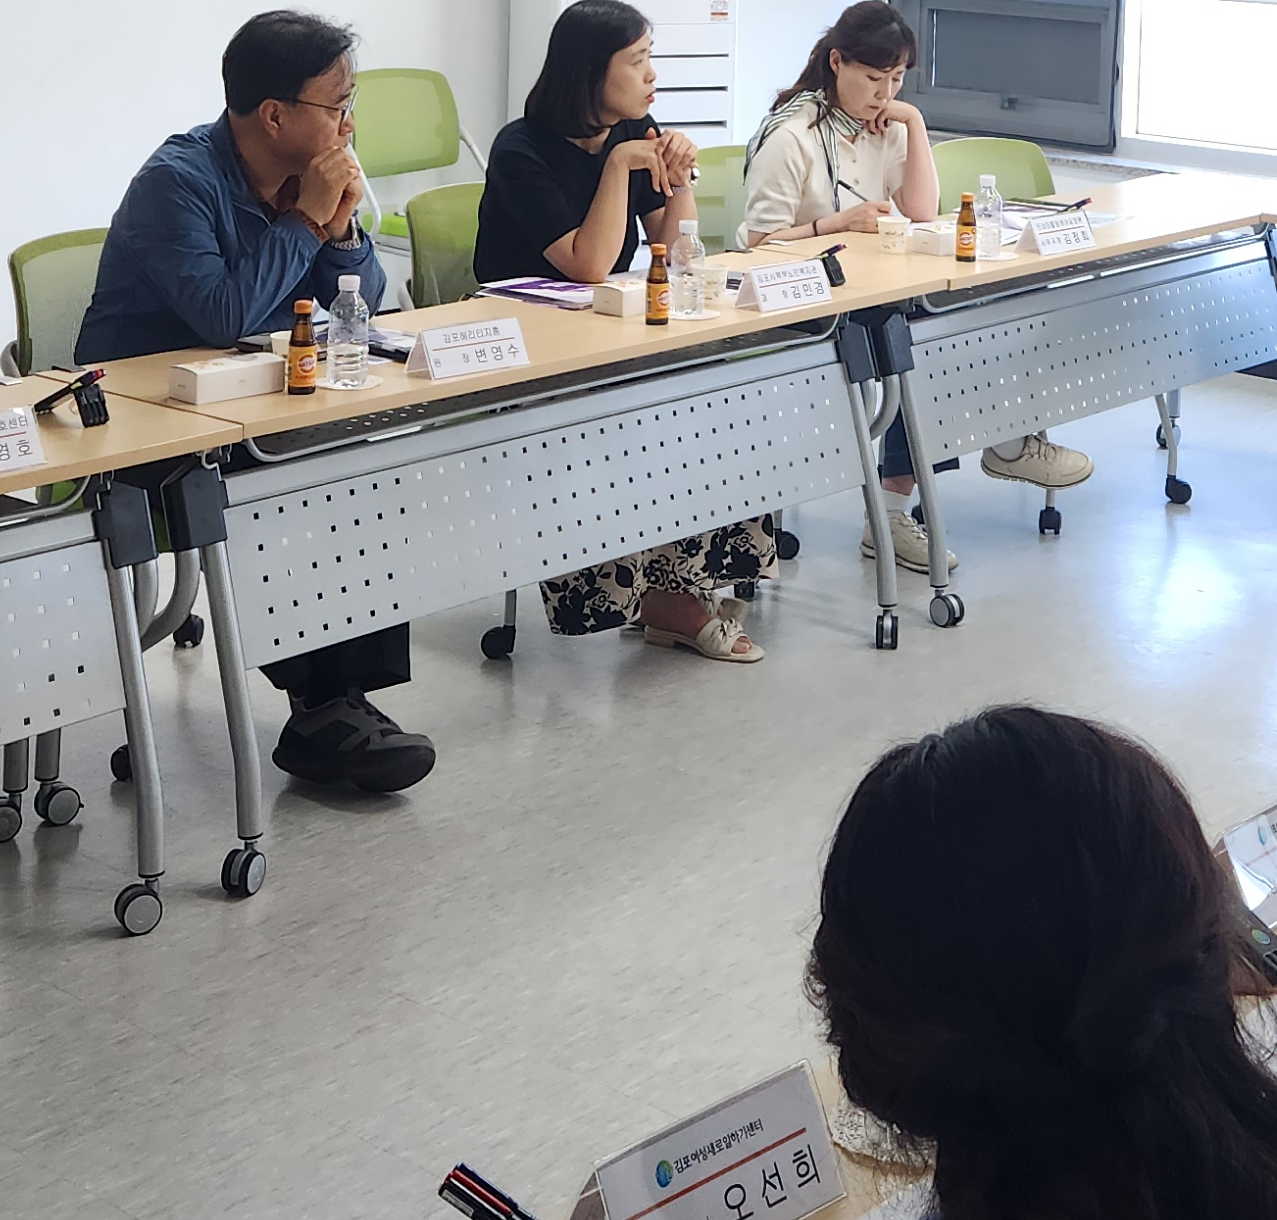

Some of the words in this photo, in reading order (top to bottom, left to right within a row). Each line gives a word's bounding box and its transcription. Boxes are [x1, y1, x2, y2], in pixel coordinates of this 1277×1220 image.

[474, 343, 520, 364] 변영수
[673, 1118, 764, 1174] 김포여성새로일하기센터
[723, 1143, 821, 1220] 오선희
